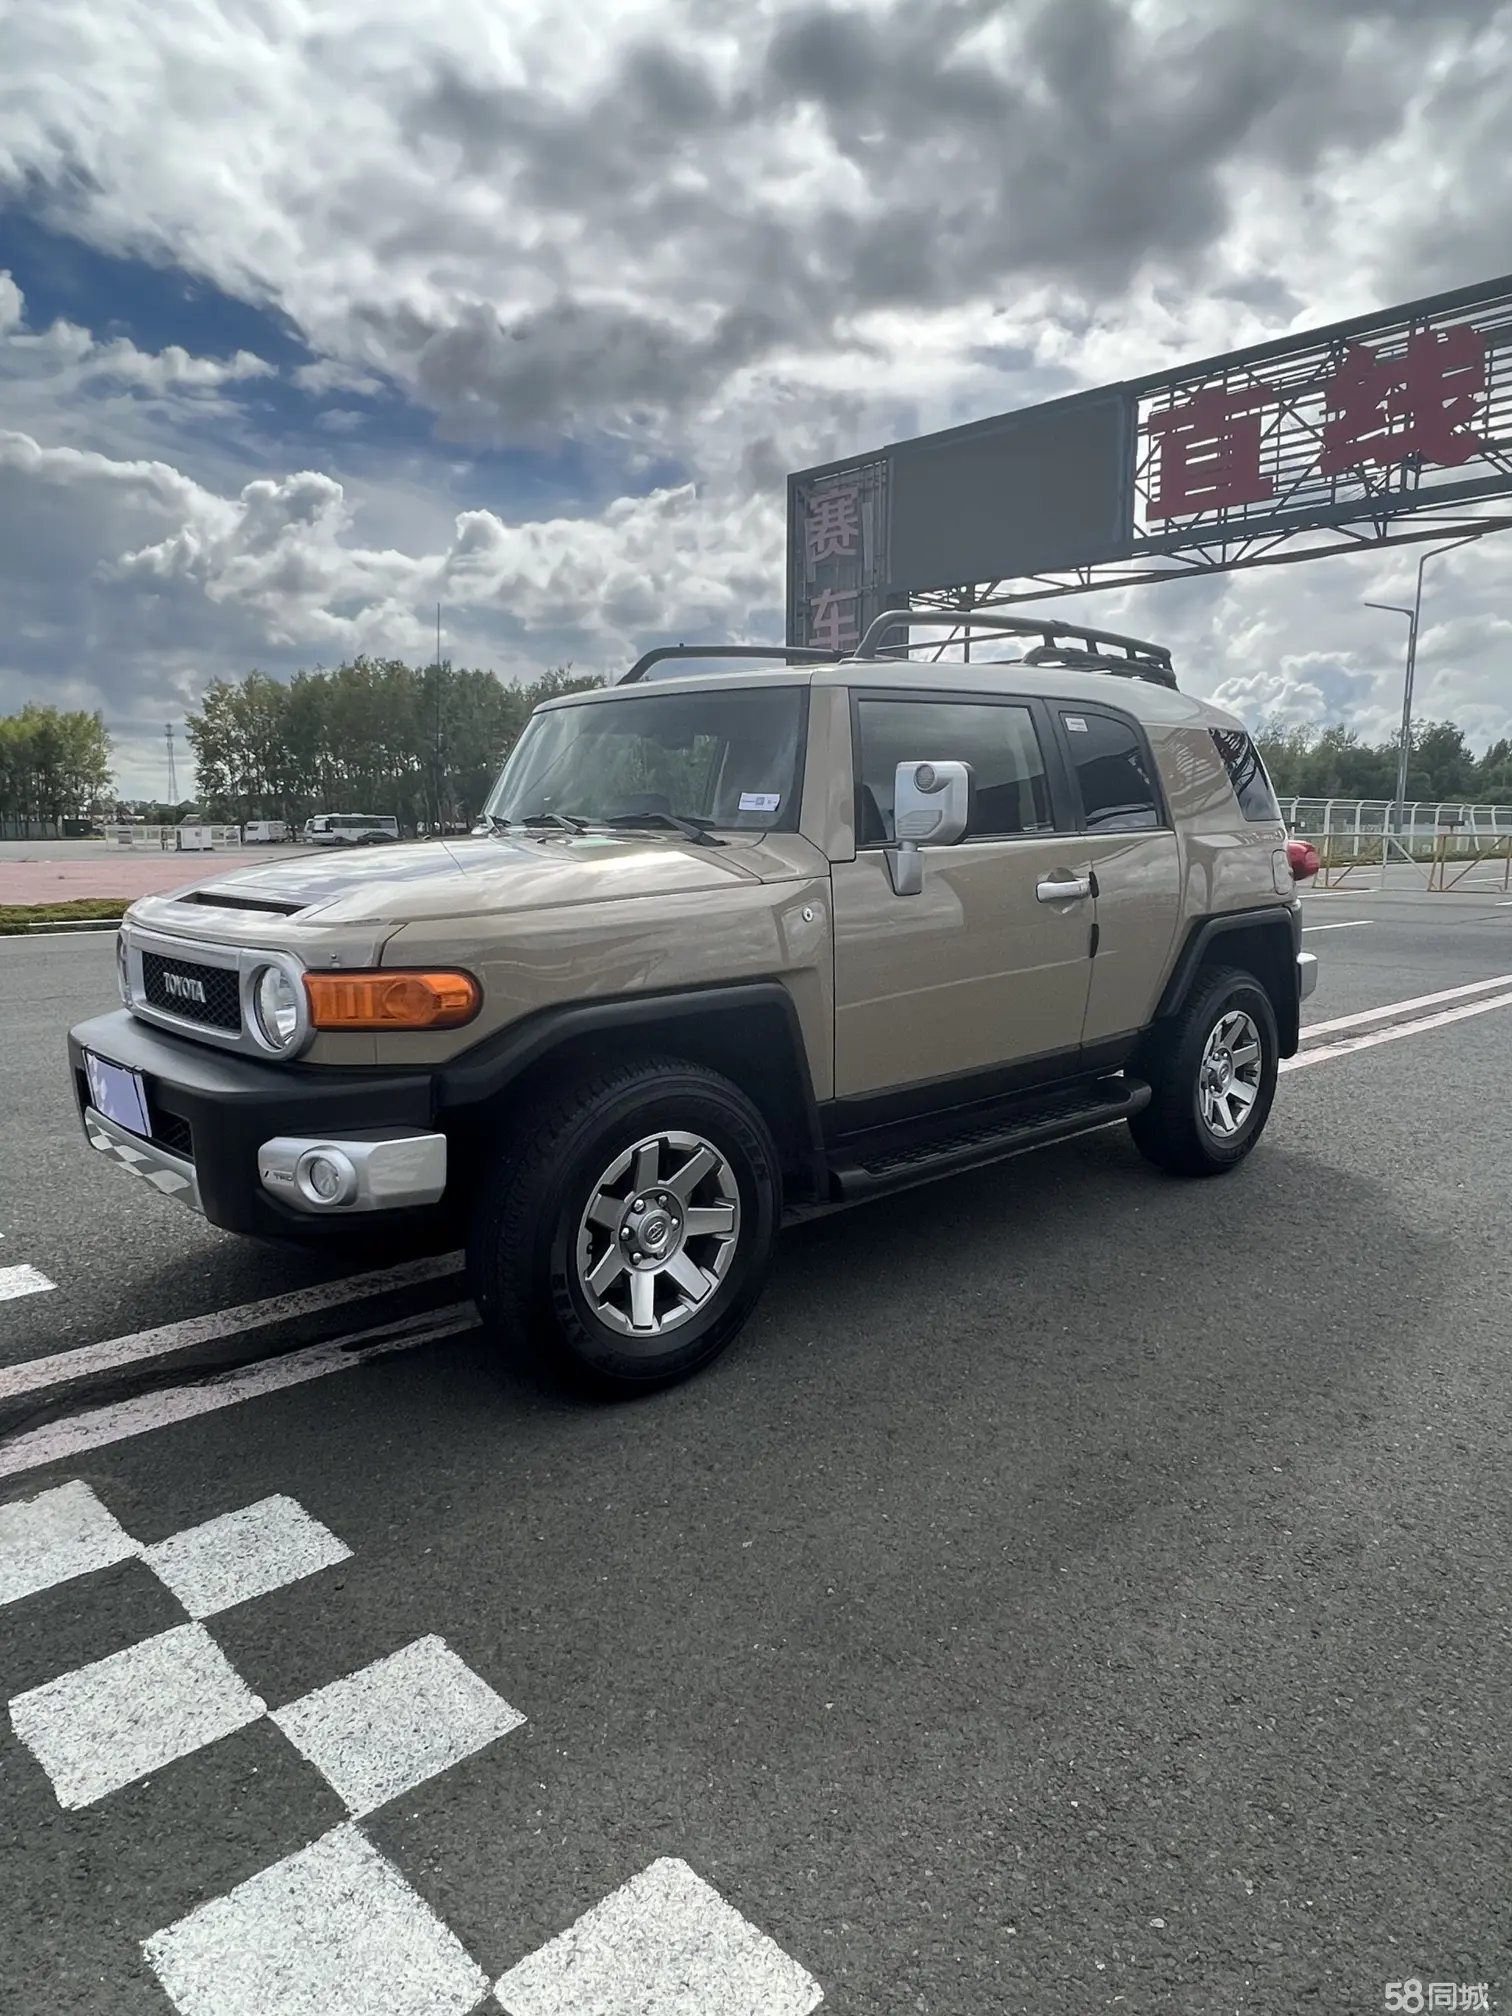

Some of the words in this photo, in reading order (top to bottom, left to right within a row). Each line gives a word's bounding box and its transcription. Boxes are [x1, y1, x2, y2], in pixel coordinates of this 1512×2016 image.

[1146, 324, 1486, 521] 直线
[808, 486, 860, 651] 赛车
[163, 971, 206, 1003] TOYOTA
